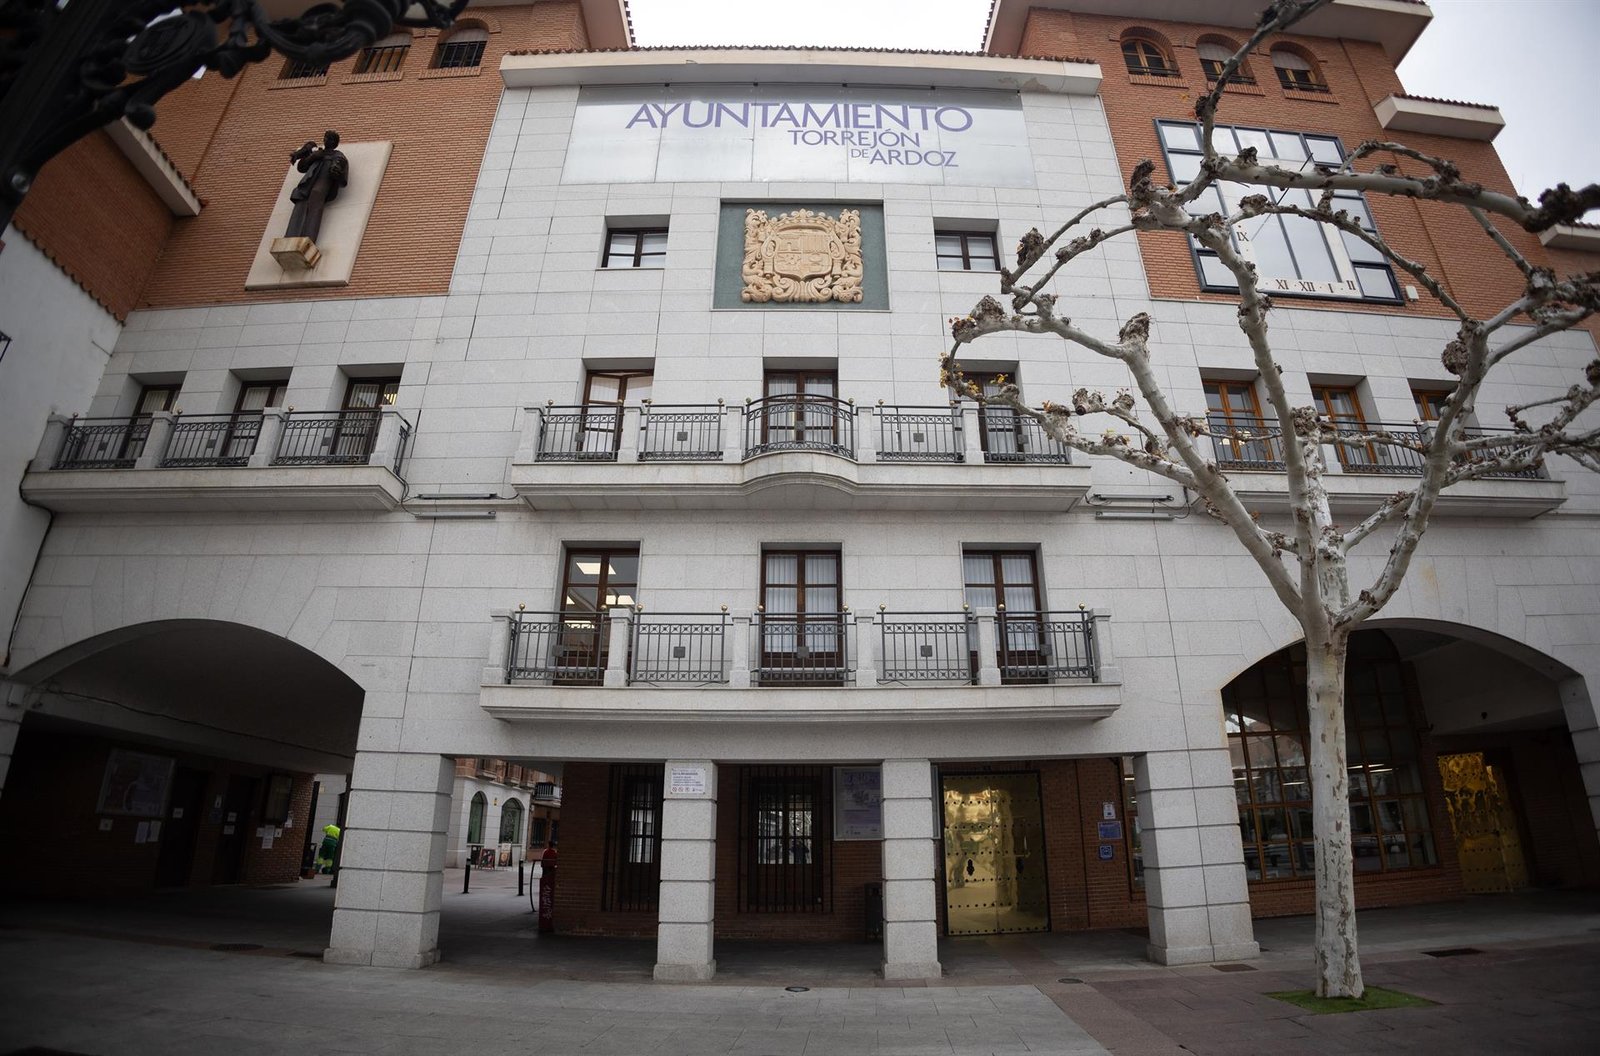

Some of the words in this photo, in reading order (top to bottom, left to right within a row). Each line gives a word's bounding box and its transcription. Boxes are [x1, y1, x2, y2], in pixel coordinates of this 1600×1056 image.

[625, 101, 973, 132] AYUNTAMIENTO
[787, 128, 920, 149] TORREJÓN
[850, 148, 870, 159] DE
[869, 149, 959, 167] ARDOZ
[1236, 231, 1249, 242] IX
[1275, 279, 1289, 290] XI
[1299, 281, 1316, 292] XII
[1346, 280, 1356, 290] II
